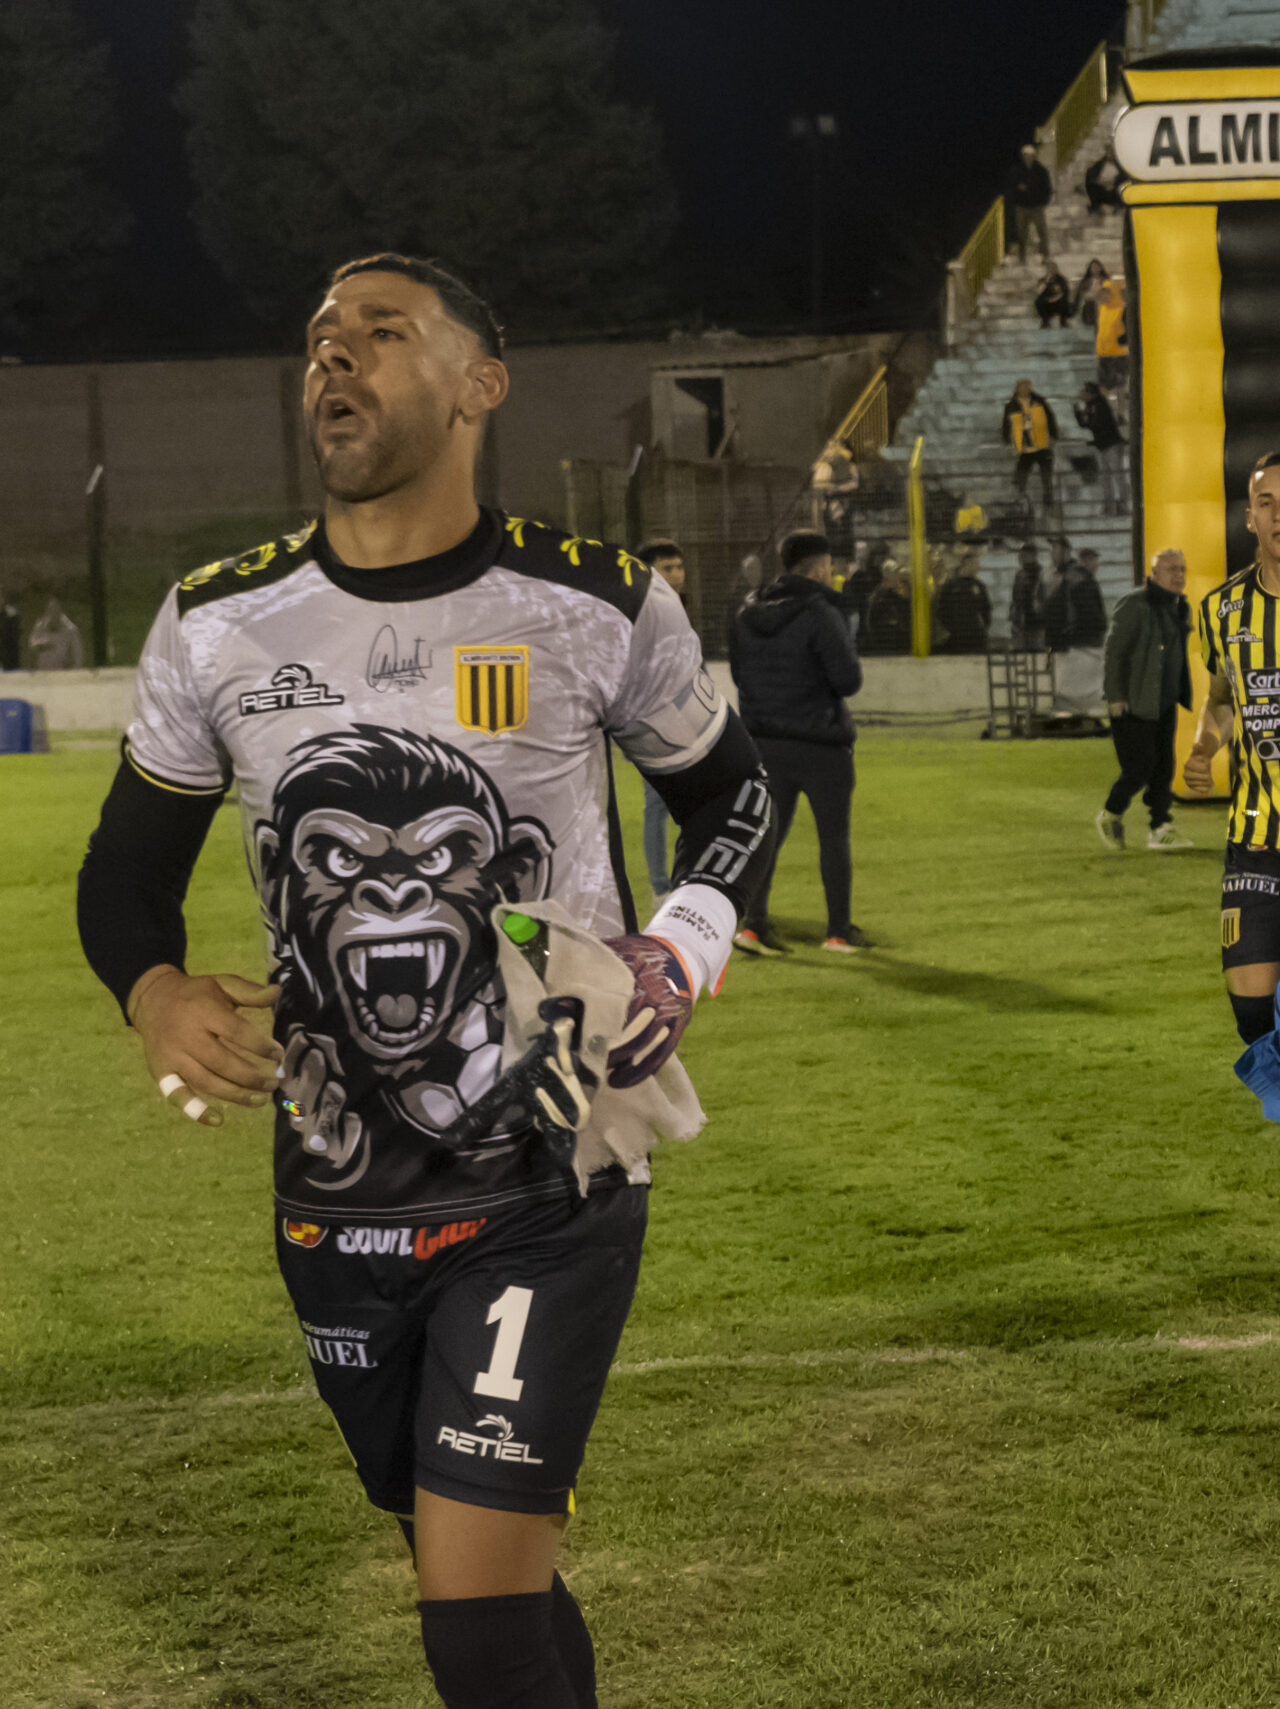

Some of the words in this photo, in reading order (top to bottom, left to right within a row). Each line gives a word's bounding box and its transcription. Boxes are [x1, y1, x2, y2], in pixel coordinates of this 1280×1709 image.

[240, 686, 344, 714] RETIEL
[472, 1285, 535, 1402] 1
[436, 1425, 544, 1465] RETIEL
